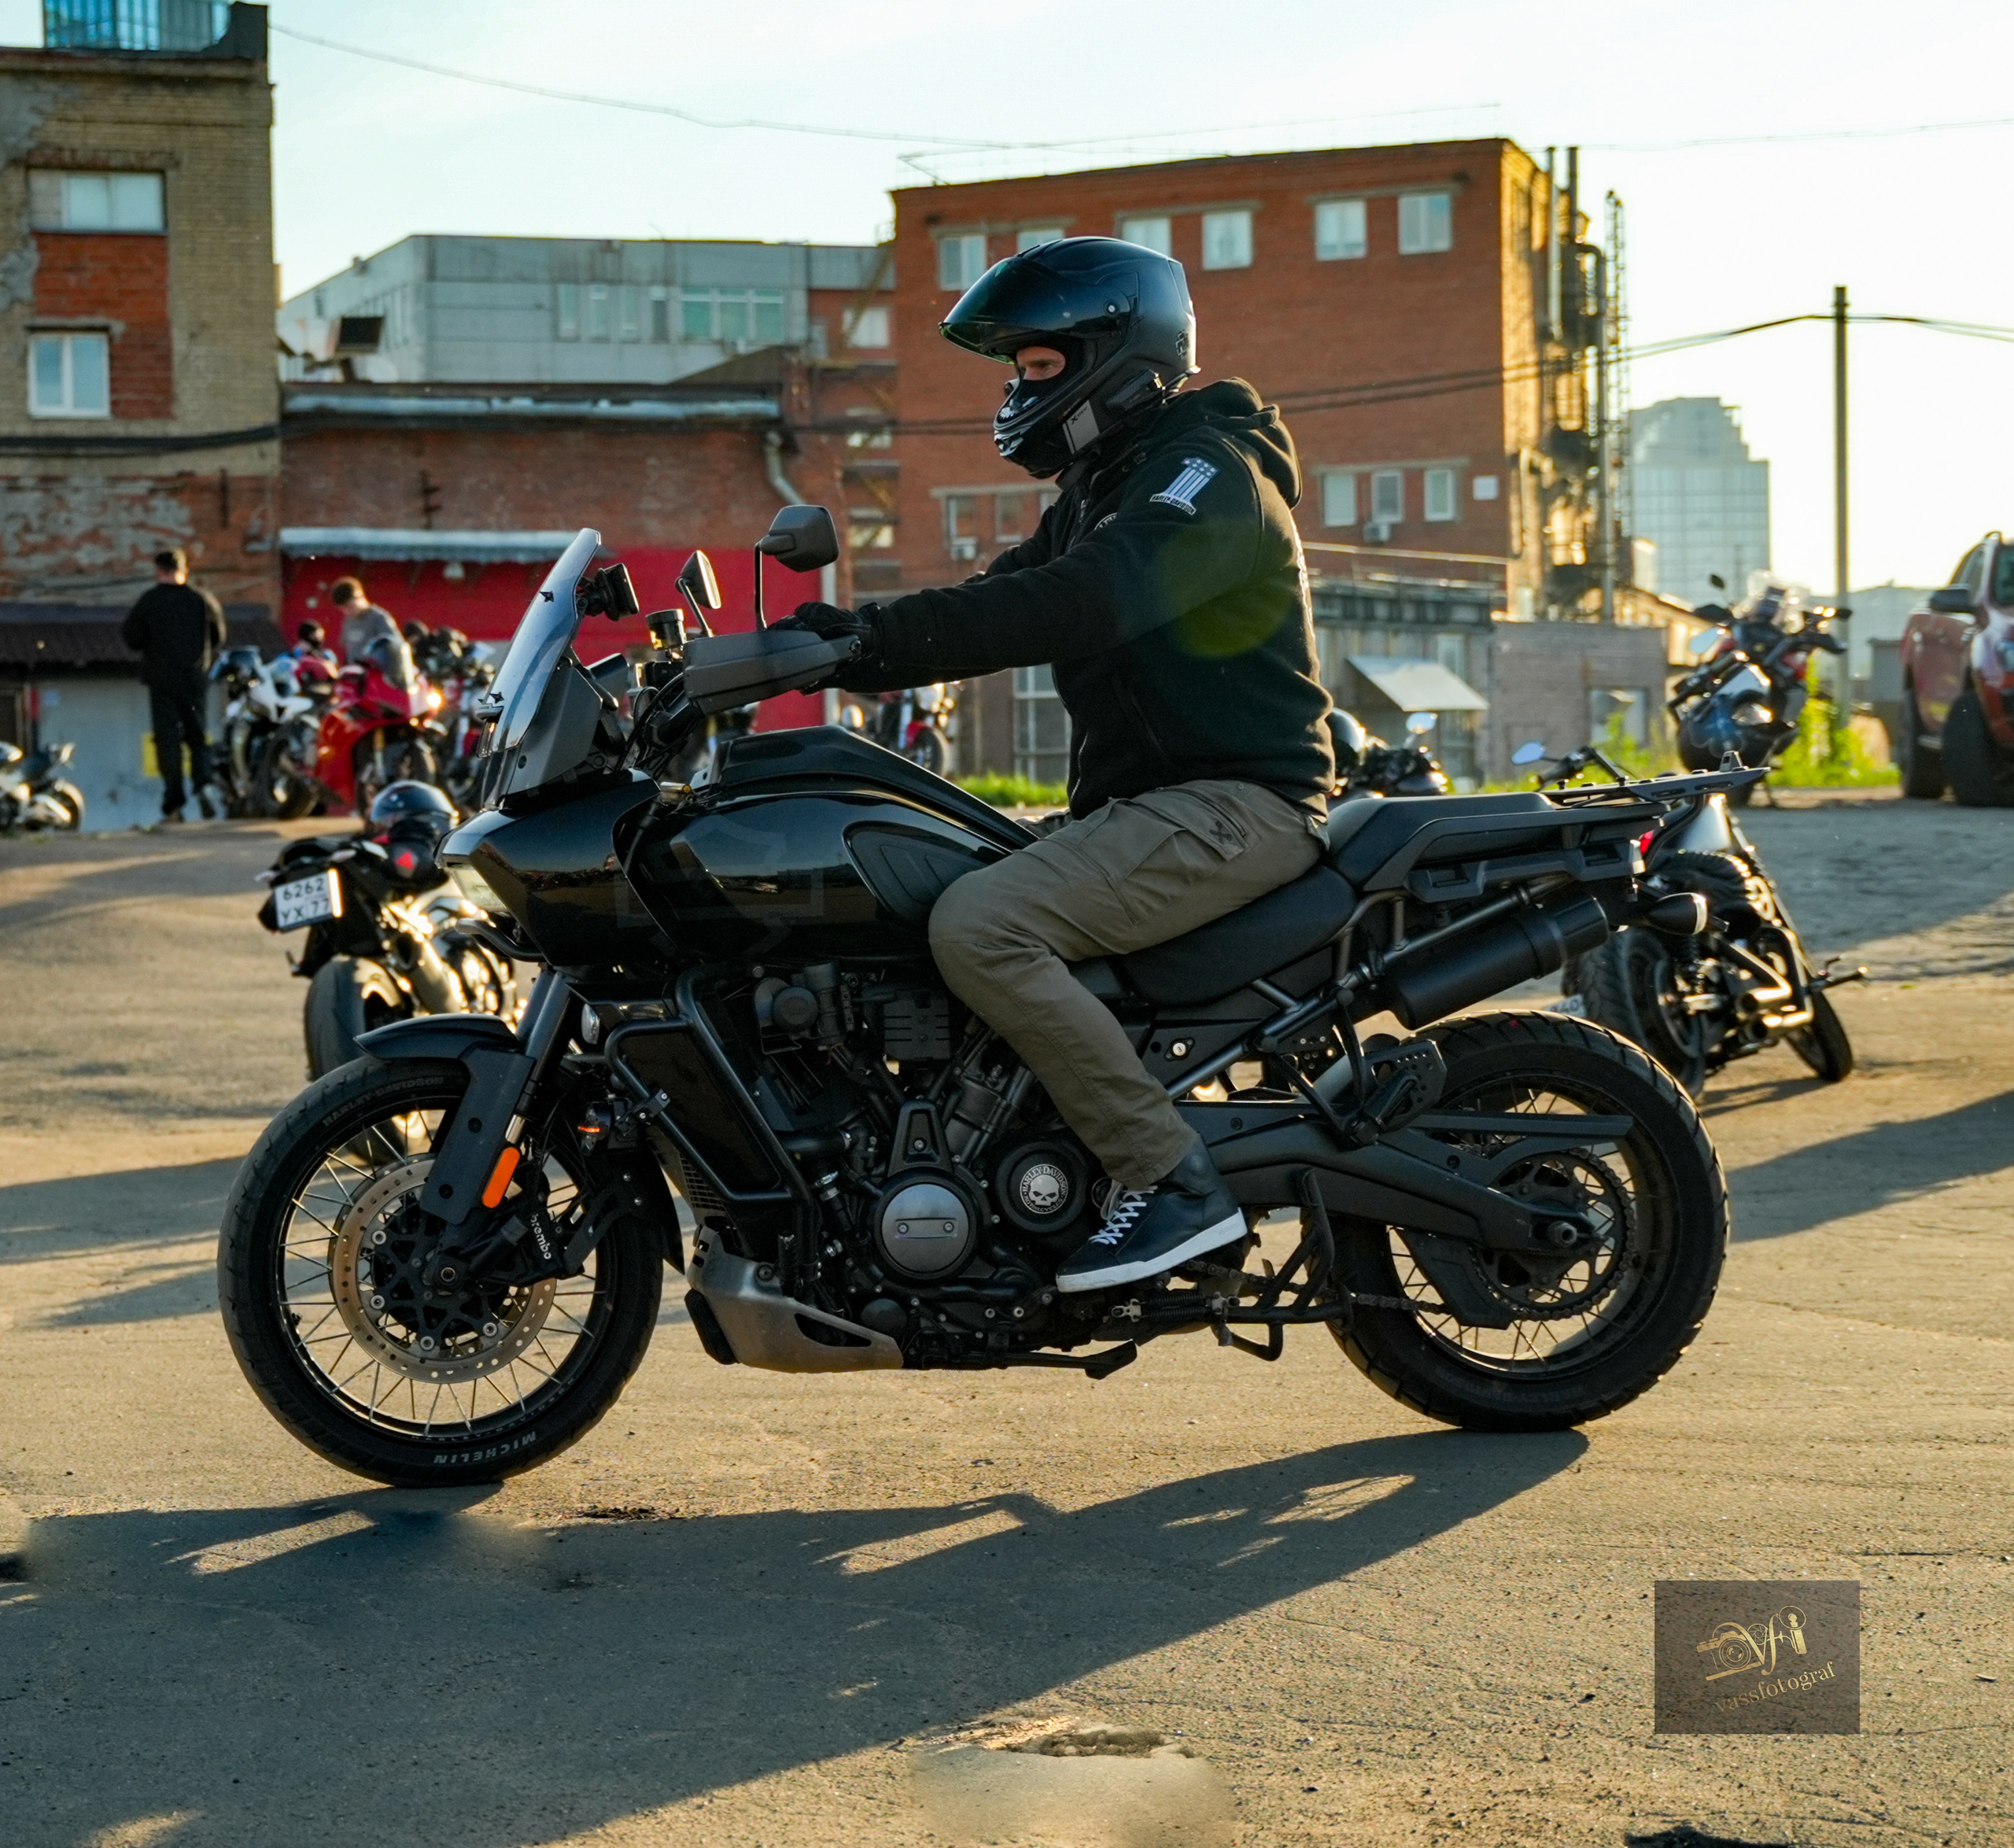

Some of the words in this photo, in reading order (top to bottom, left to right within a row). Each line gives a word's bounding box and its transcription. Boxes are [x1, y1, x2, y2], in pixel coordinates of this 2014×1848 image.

[283, 878, 323, 900] 6262
[1022, 1165, 1067, 1195] HARLEY-DAVIDSON
[530, 1212, 551, 1260] brembo
[433, 1430, 537, 1464] MICHELIN
